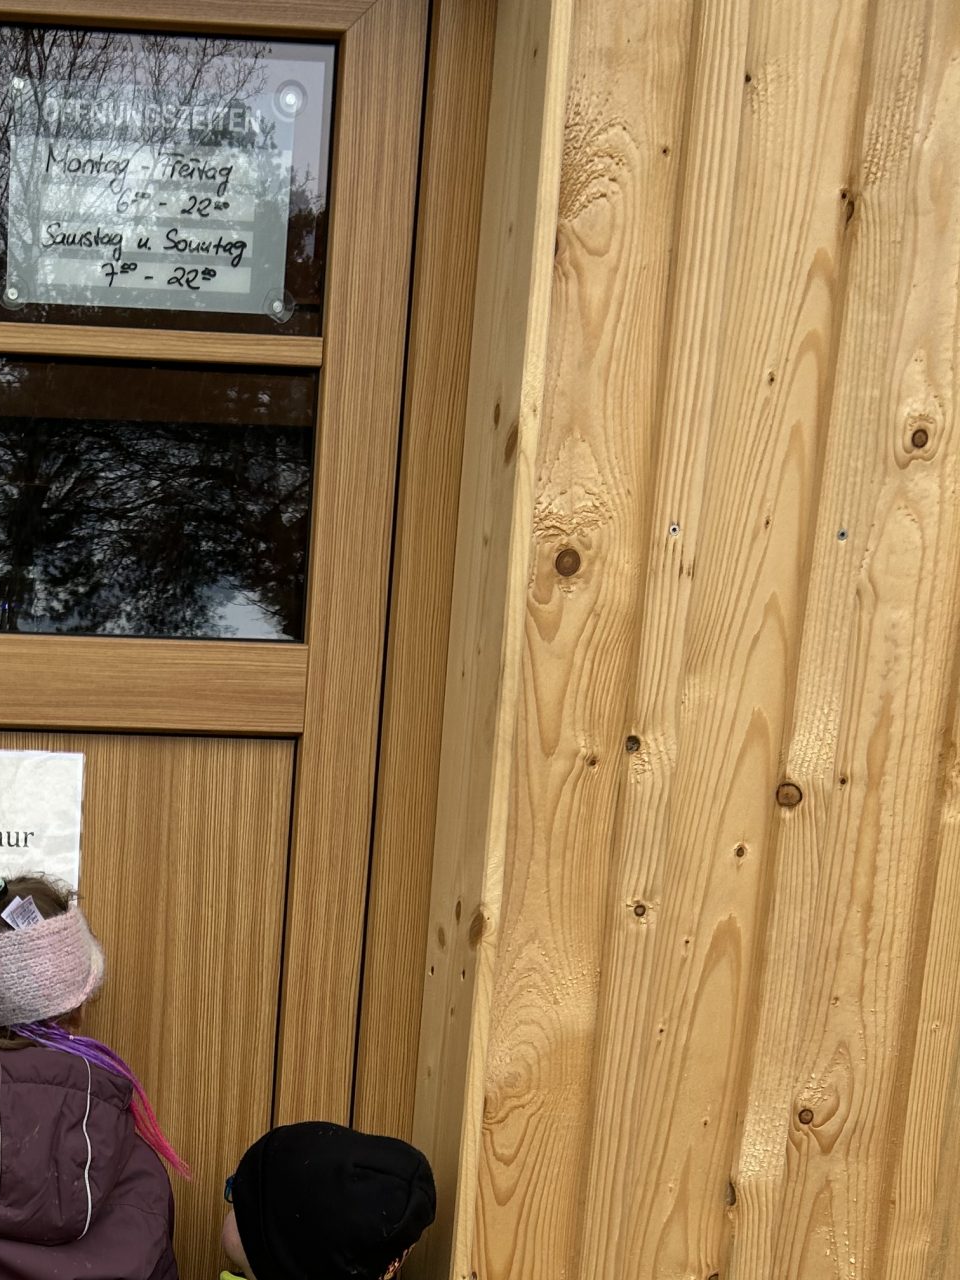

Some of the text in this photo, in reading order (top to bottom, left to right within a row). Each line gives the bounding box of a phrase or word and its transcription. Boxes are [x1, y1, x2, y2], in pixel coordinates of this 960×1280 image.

[45, 143, 130, 195] Montag
[158, 152, 233, 198] Freitag
[137, 237, 152, 251] u.
[163, 228, 247, 268] Sonntag
